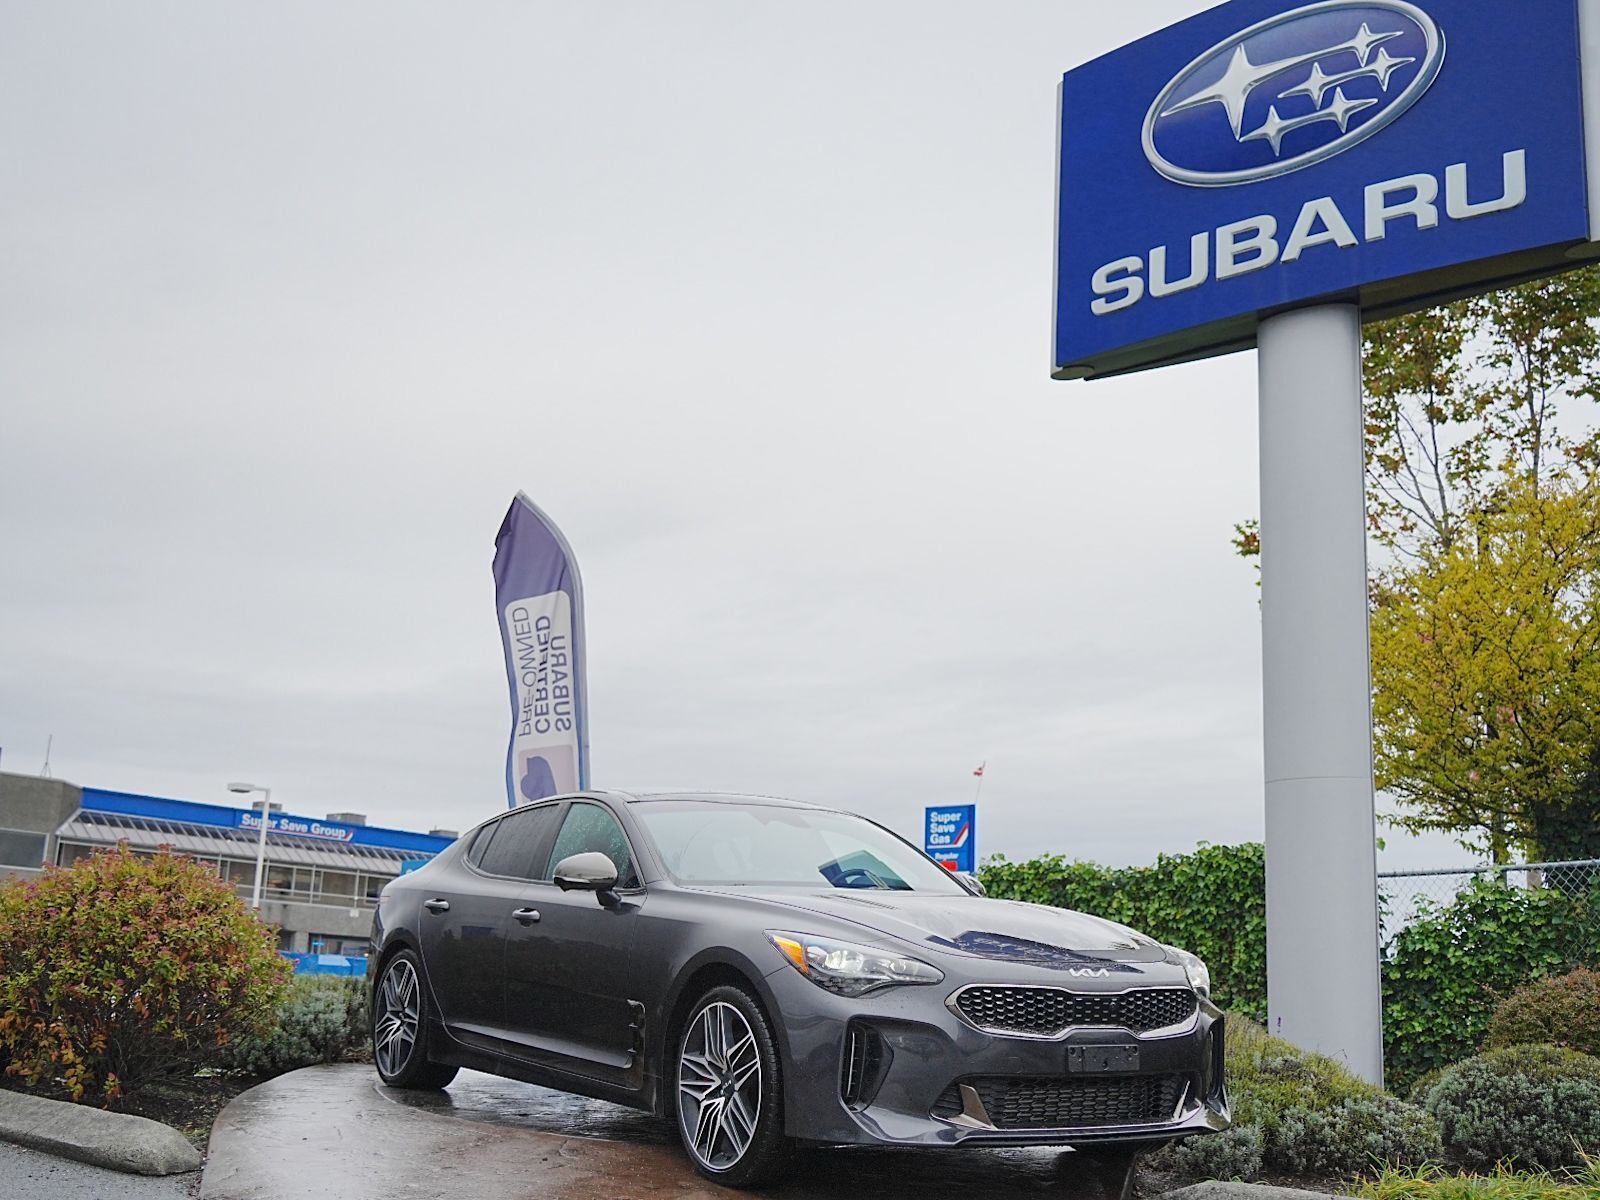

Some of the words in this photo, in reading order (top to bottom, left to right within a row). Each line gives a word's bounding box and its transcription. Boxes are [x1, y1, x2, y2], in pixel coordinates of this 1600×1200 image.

[1090, 149, 1527, 316] SUBARU
[930, 812, 961, 824] Super
[280, 819, 309, 833] Save
[311, 823, 346, 839] Group
[930, 823, 955, 833] Save
[930, 834, 950, 844] Gas
